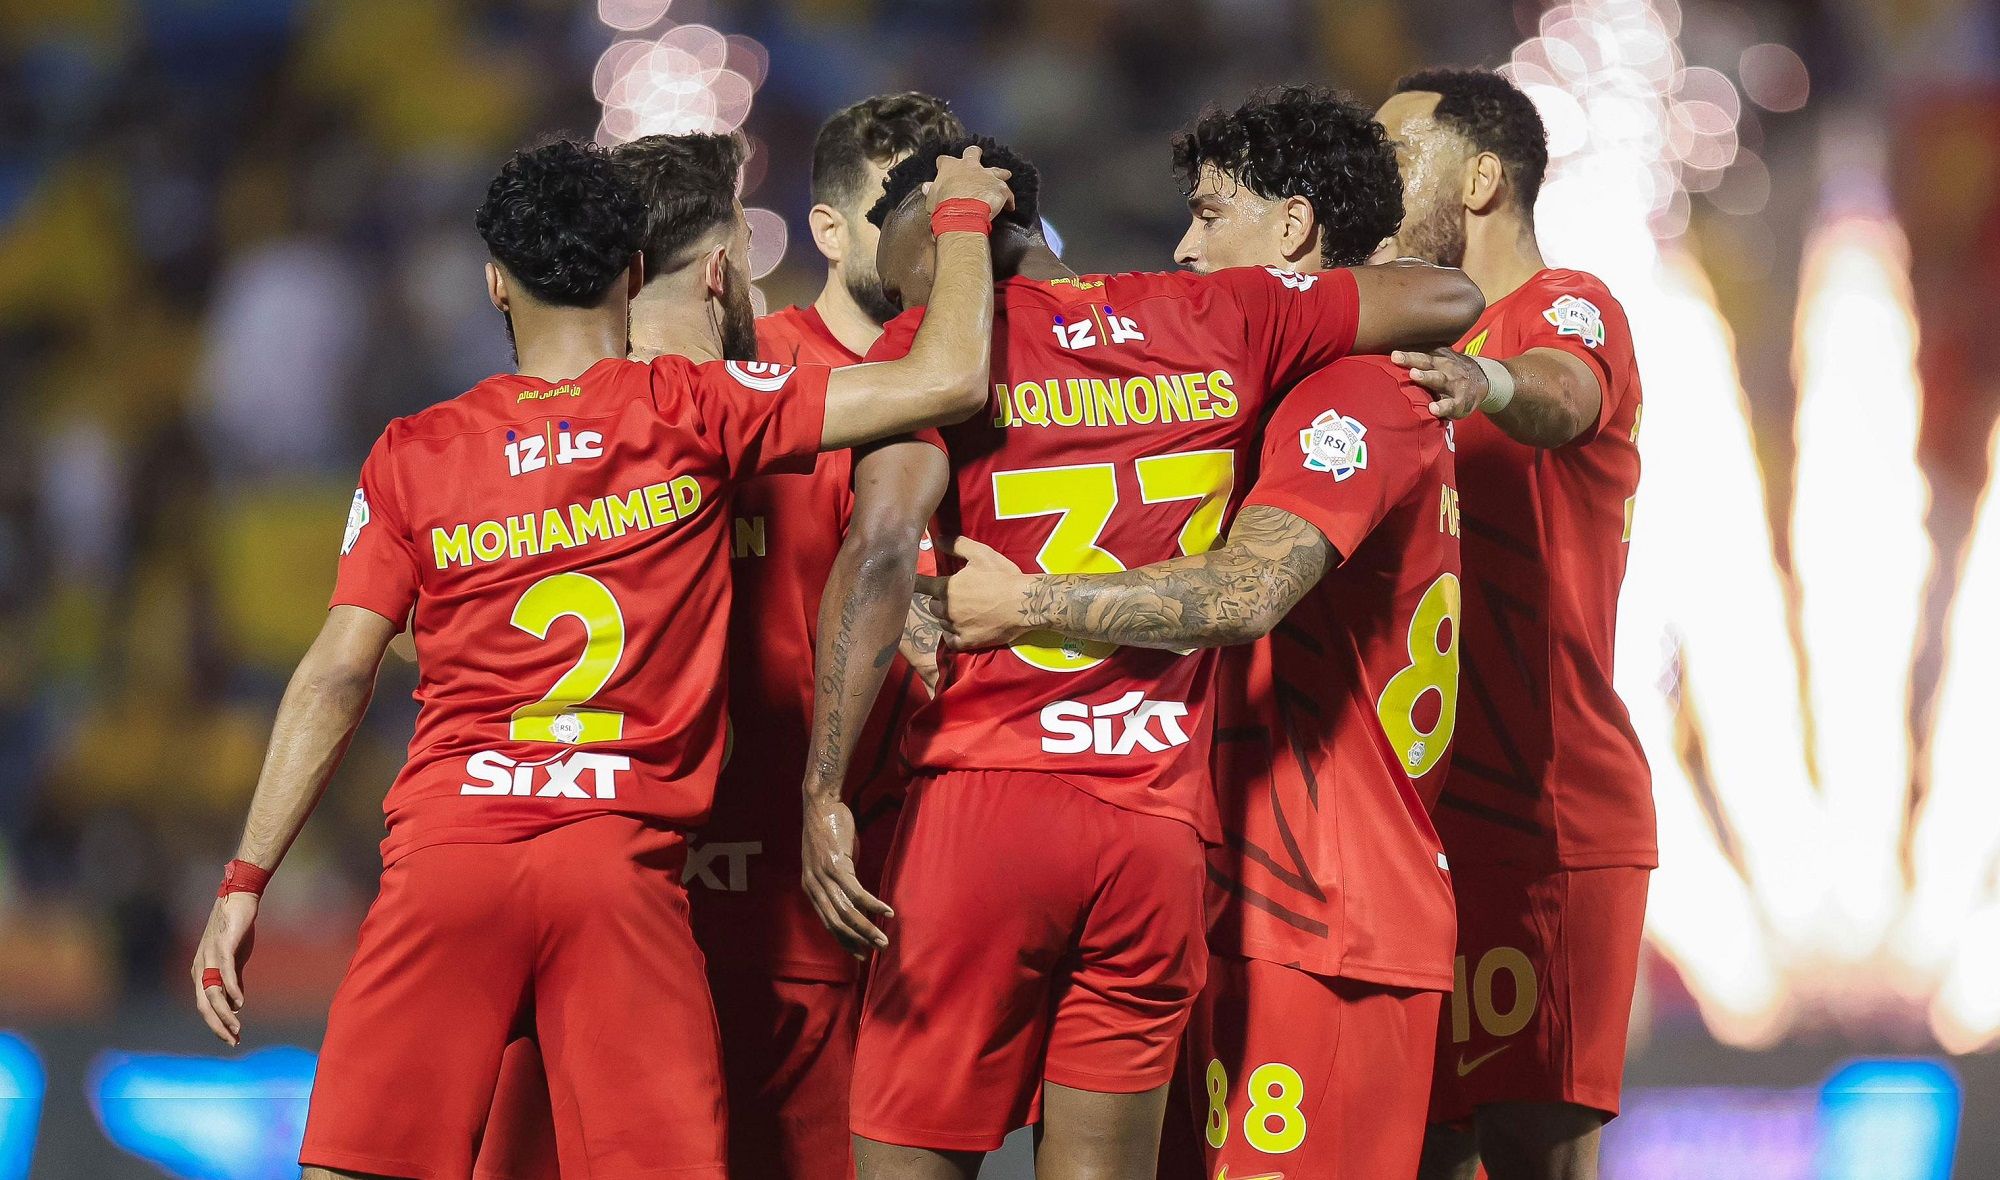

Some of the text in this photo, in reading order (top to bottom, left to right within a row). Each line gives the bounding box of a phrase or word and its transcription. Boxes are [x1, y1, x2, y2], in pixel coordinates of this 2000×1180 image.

[993, 370, 1239, 428] J.QUINONES
[1323, 434, 1346, 454] RSL
[431, 475, 702, 570] MOHAMMED
[731, 515, 766, 558] N
[510, 571, 625, 745] 2
[1376, 571, 1461, 778] 8
[1451, 945, 1538, 1043] 10
[1205, 1058, 1229, 1148] 8
[1243, 1061, 1307, 1154] 8
